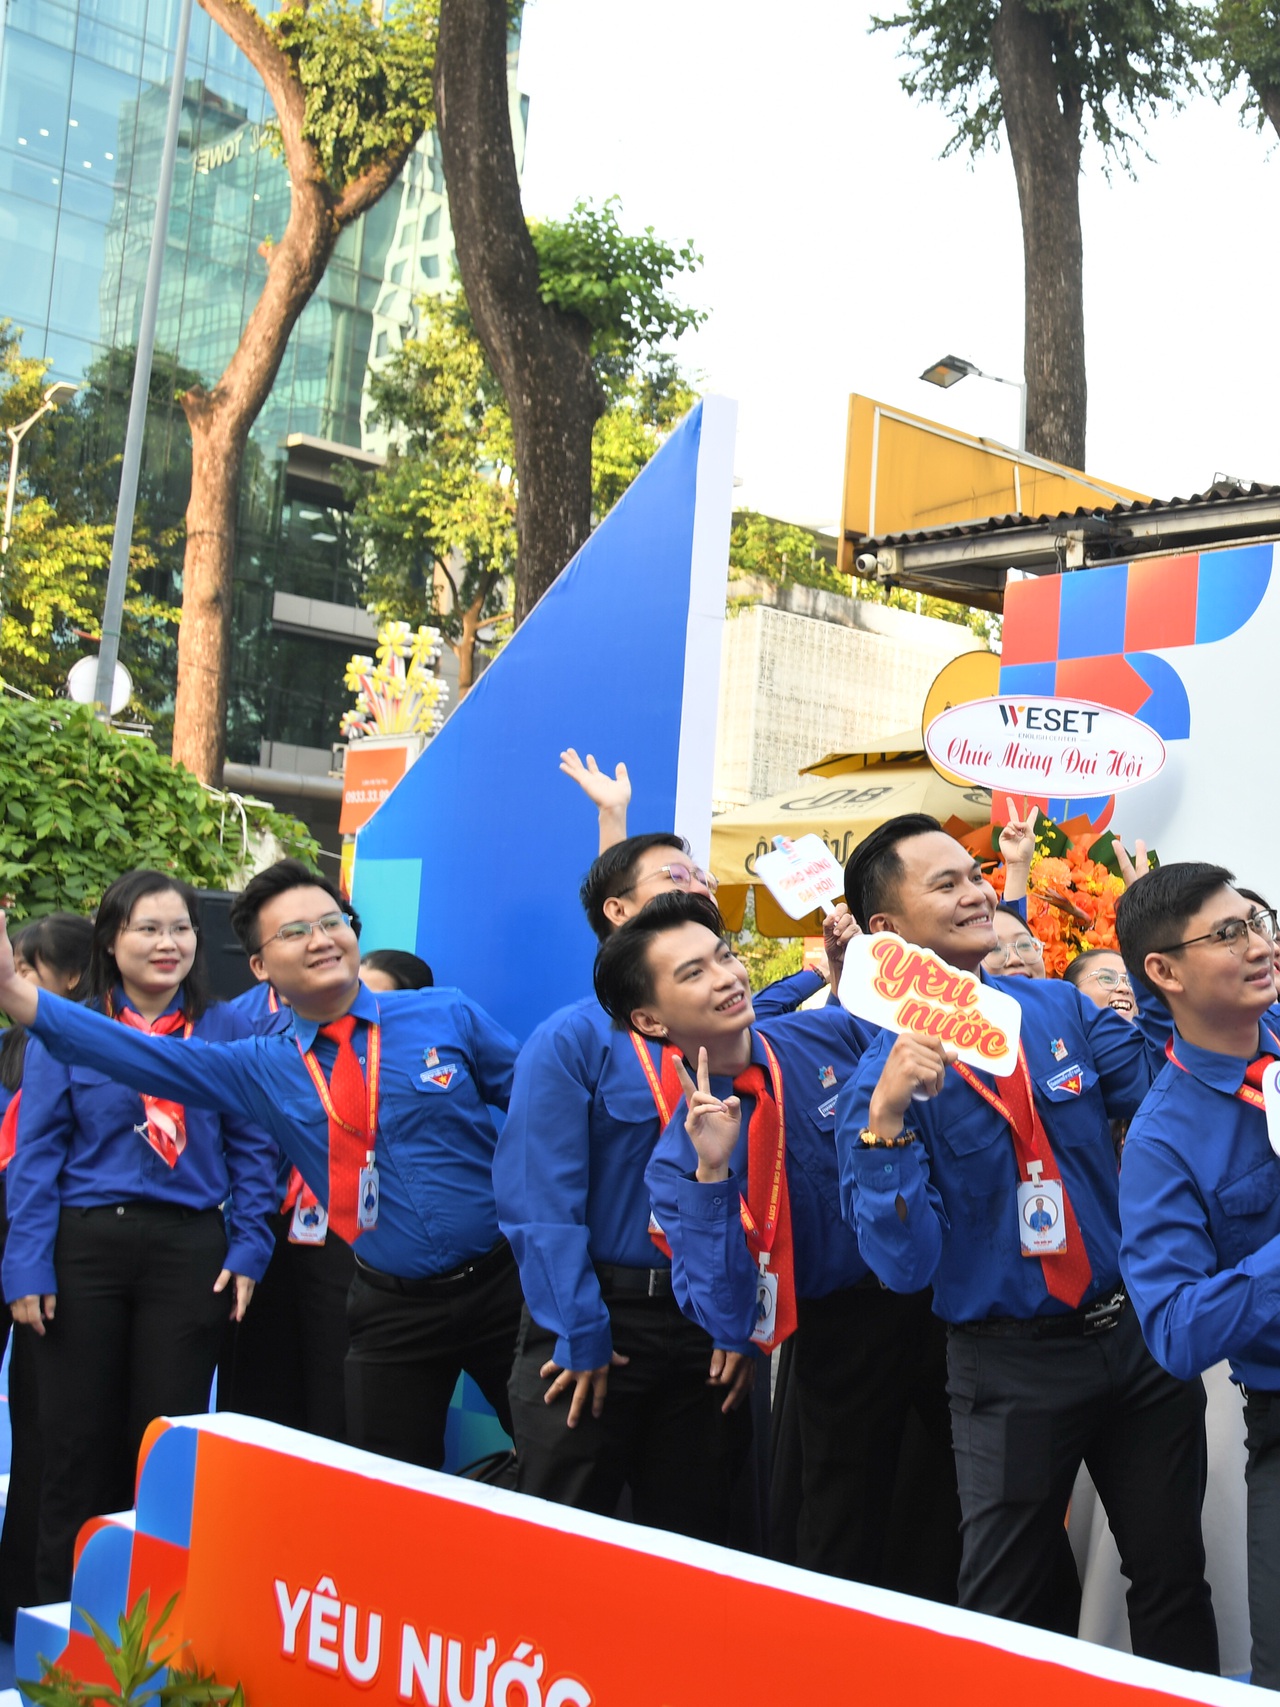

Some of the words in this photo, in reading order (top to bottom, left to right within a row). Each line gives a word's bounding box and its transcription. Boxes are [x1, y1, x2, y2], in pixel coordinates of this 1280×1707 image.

[998, 704, 1100, 734] WESET
[947, 737, 993, 766] Chúc
[997, 741, 1053, 777] Mừng
[1060, 746, 1099, 780] Đại
[1106, 749, 1144, 783] Hội
[872, 938, 978, 1007] Yêu
[897, 998, 1009, 1058] nước
[274, 1575, 382, 1683] YÊU
